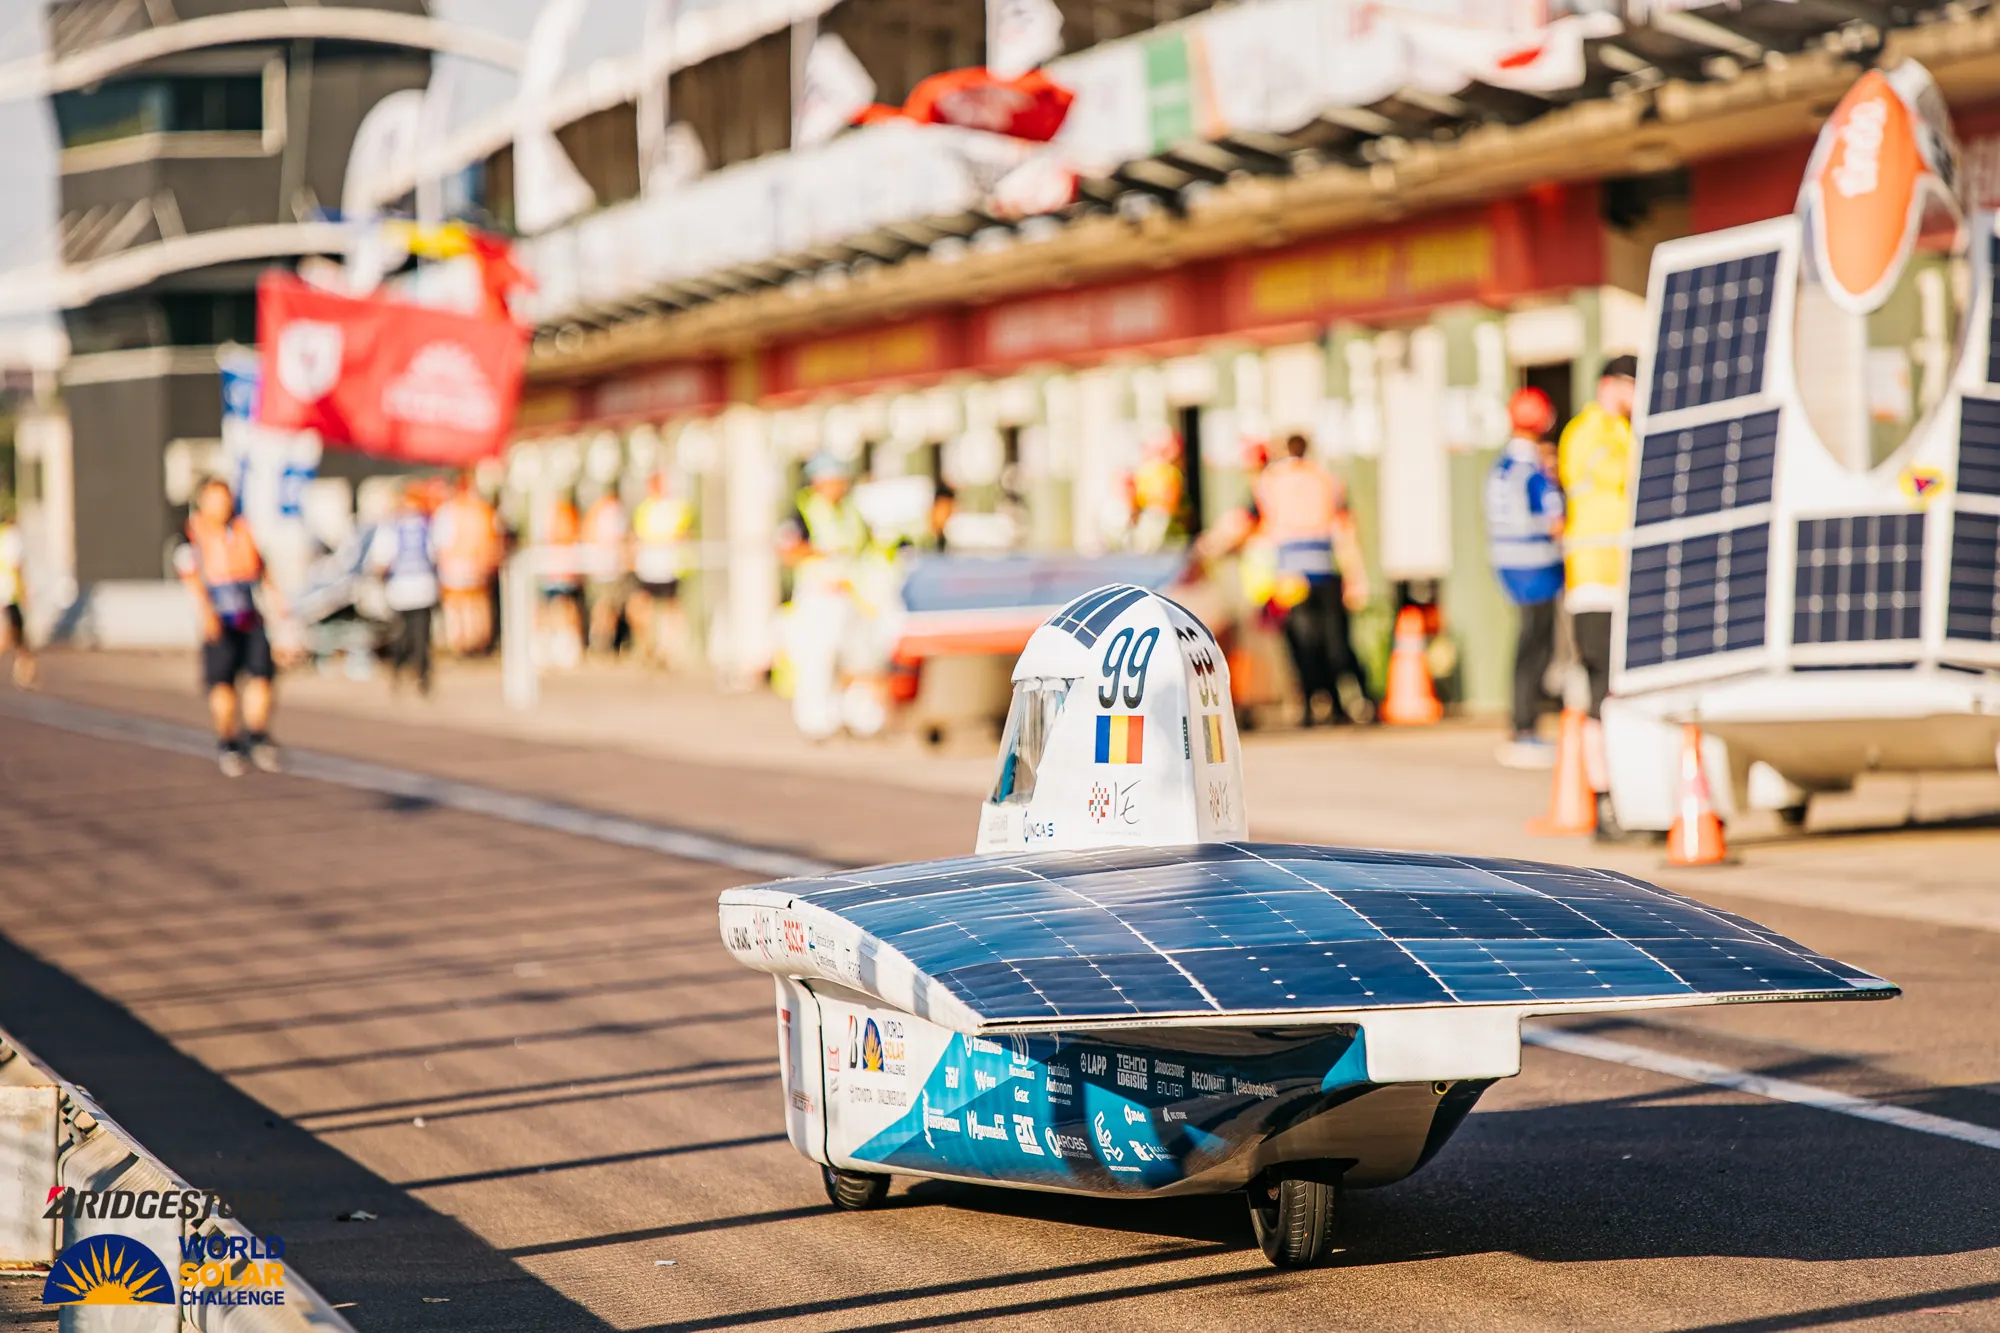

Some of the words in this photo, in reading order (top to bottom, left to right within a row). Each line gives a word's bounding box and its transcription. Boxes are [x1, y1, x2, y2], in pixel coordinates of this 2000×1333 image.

[1098, 626, 1160, 709] 99
[1087, 1053, 1107, 1076] LAPP
[1117, 1053, 1148, 1073] TEHNO
[1045, 1076, 1073, 1096] Autonom
[1117, 1071, 1148, 1091] LOGISTIC
[1056, 1134, 1088, 1152] AROBS
